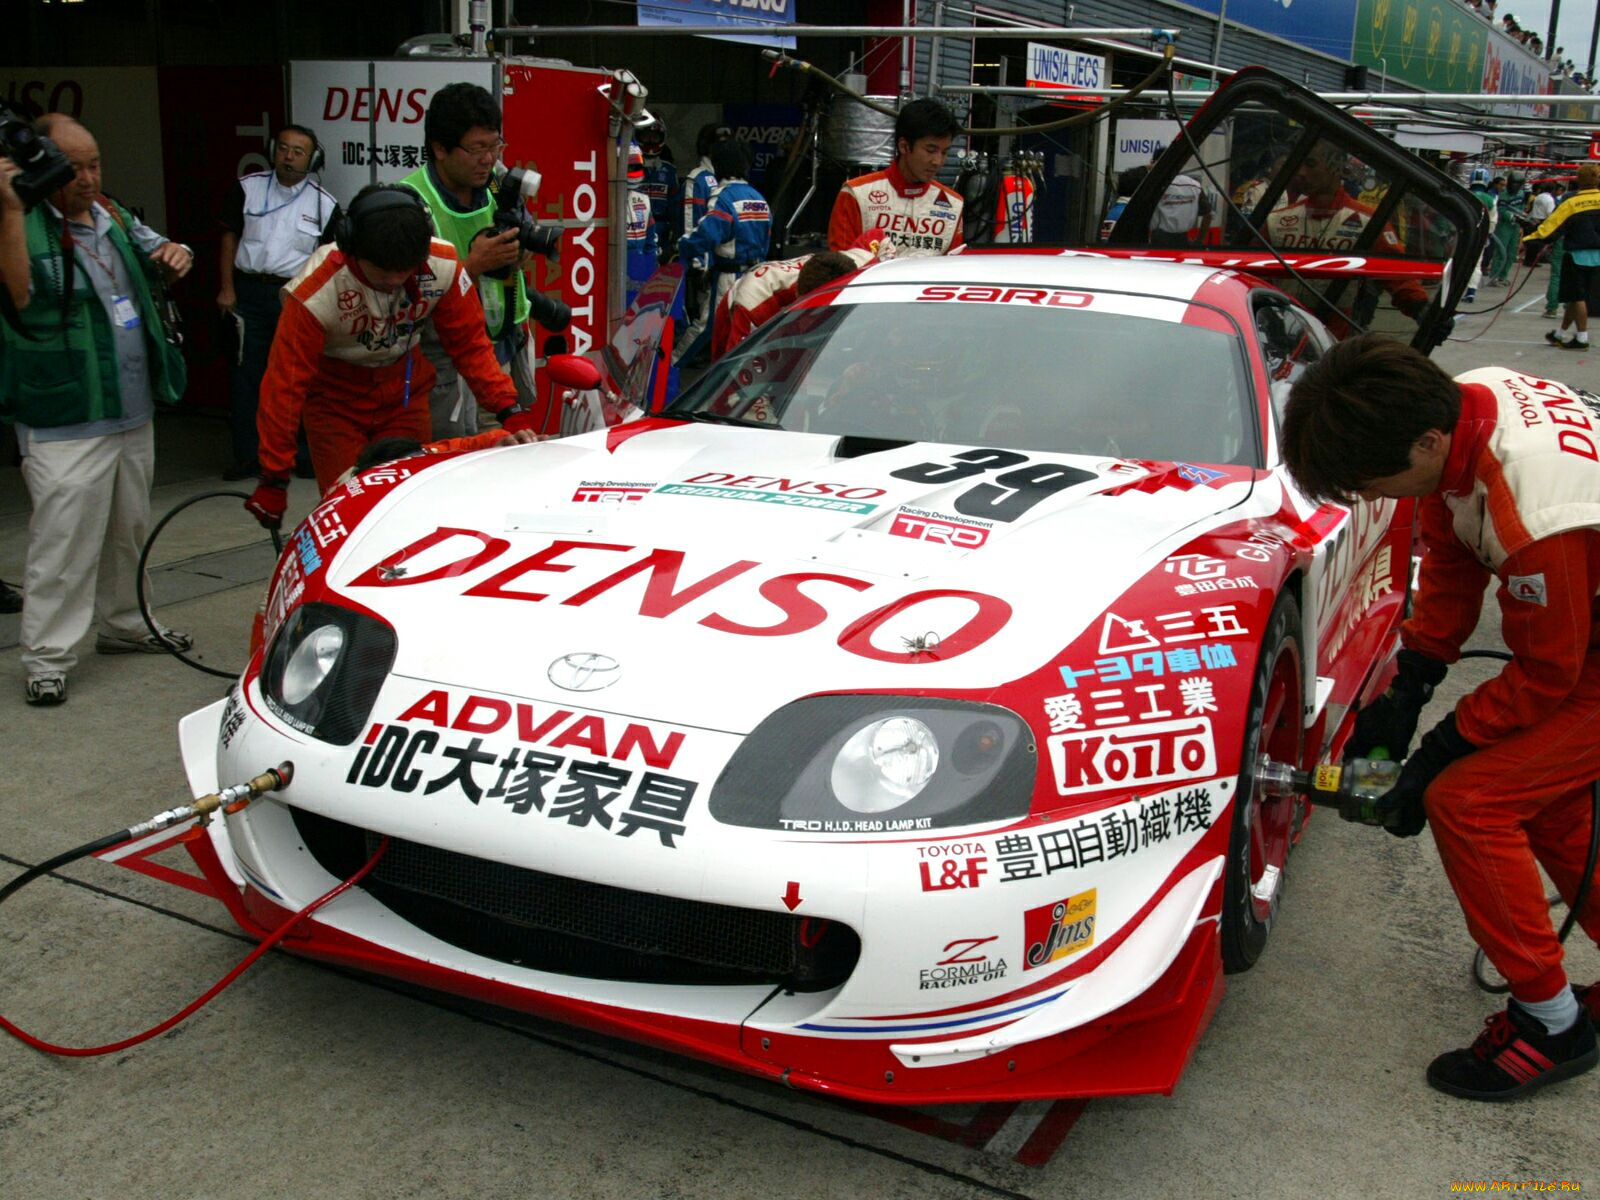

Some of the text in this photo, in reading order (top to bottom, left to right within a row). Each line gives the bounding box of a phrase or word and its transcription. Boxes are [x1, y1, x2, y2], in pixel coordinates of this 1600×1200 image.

[1034, 48, 1099, 88] UNISIA JECS
[1120, 139, 1162, 153] UNISIA
[876, 213, 945, 235] DENSO
[570, 150, 597, 357] TOYOTA
[1503, 379, 1542, 428] TOYOTA
[579, 480, 659, 488] Racing Development
[681, 472, 886, 500] DENSO
[889, 448, 1099, 523] 39
[664, 486, 871, 514] IRIDIUM POWER
[899, 506, 994, 529] Racing Development
[896, 518, 984, 548] TRD
[346, 526, 1013, 663] DENSO
[1059, 643, 1238, 689] トヨタ車体
[1044, 677, 1218, 733] 愛三工業
[395, 690, 686, 770] ADVAN
[779, 817, 932, 832] TRD H.I.D. HEAD LAMP KIT
[995, 788, 1213, 883] 豊田自動織機
[917, 843, 985, 858] TOYOTA
[919, 857, 988, 892] L&F
[919, 971, 1008, 990] RACING OIL
[920, 958, 1008, 981] FORMULA
